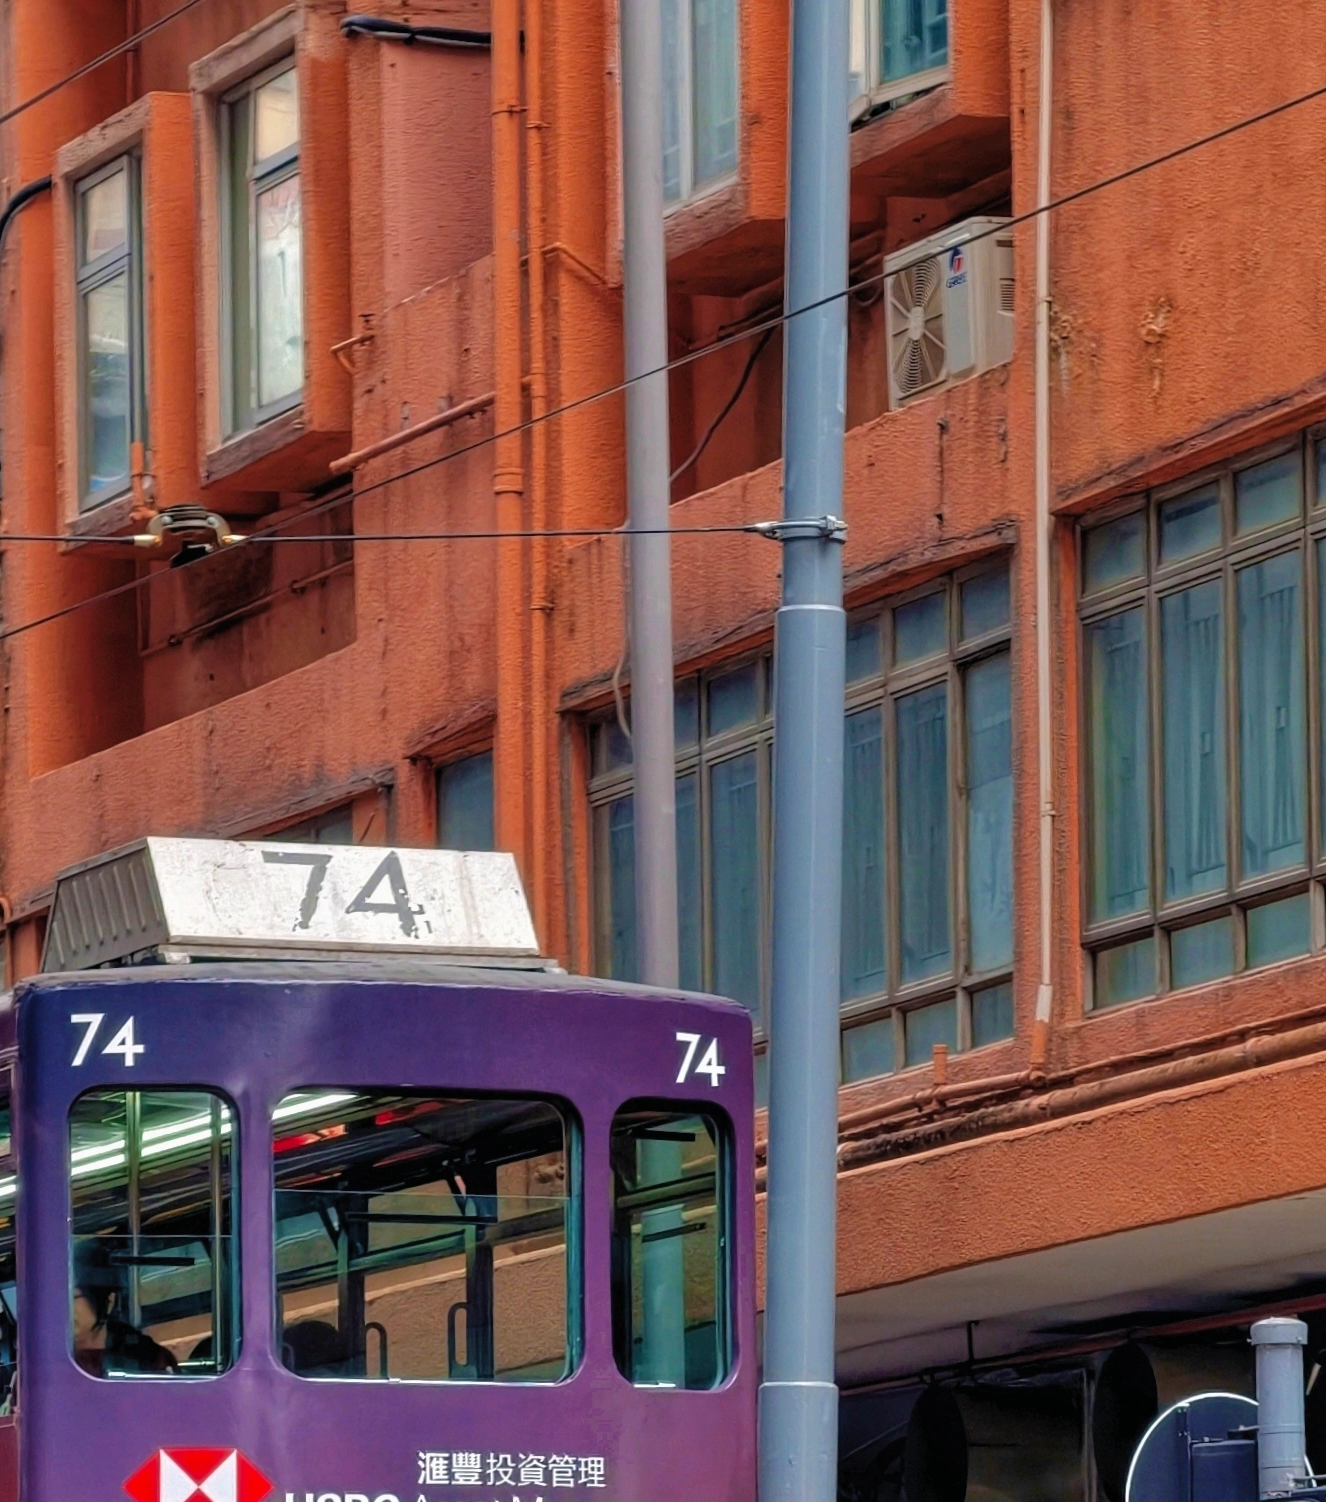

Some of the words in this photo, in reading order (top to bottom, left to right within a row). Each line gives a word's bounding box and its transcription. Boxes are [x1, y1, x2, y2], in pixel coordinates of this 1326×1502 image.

[262, 850, 425, 938] 74
[71, 1014, 144, 1067] 74
[676, 1032, 725, 1087] 74
